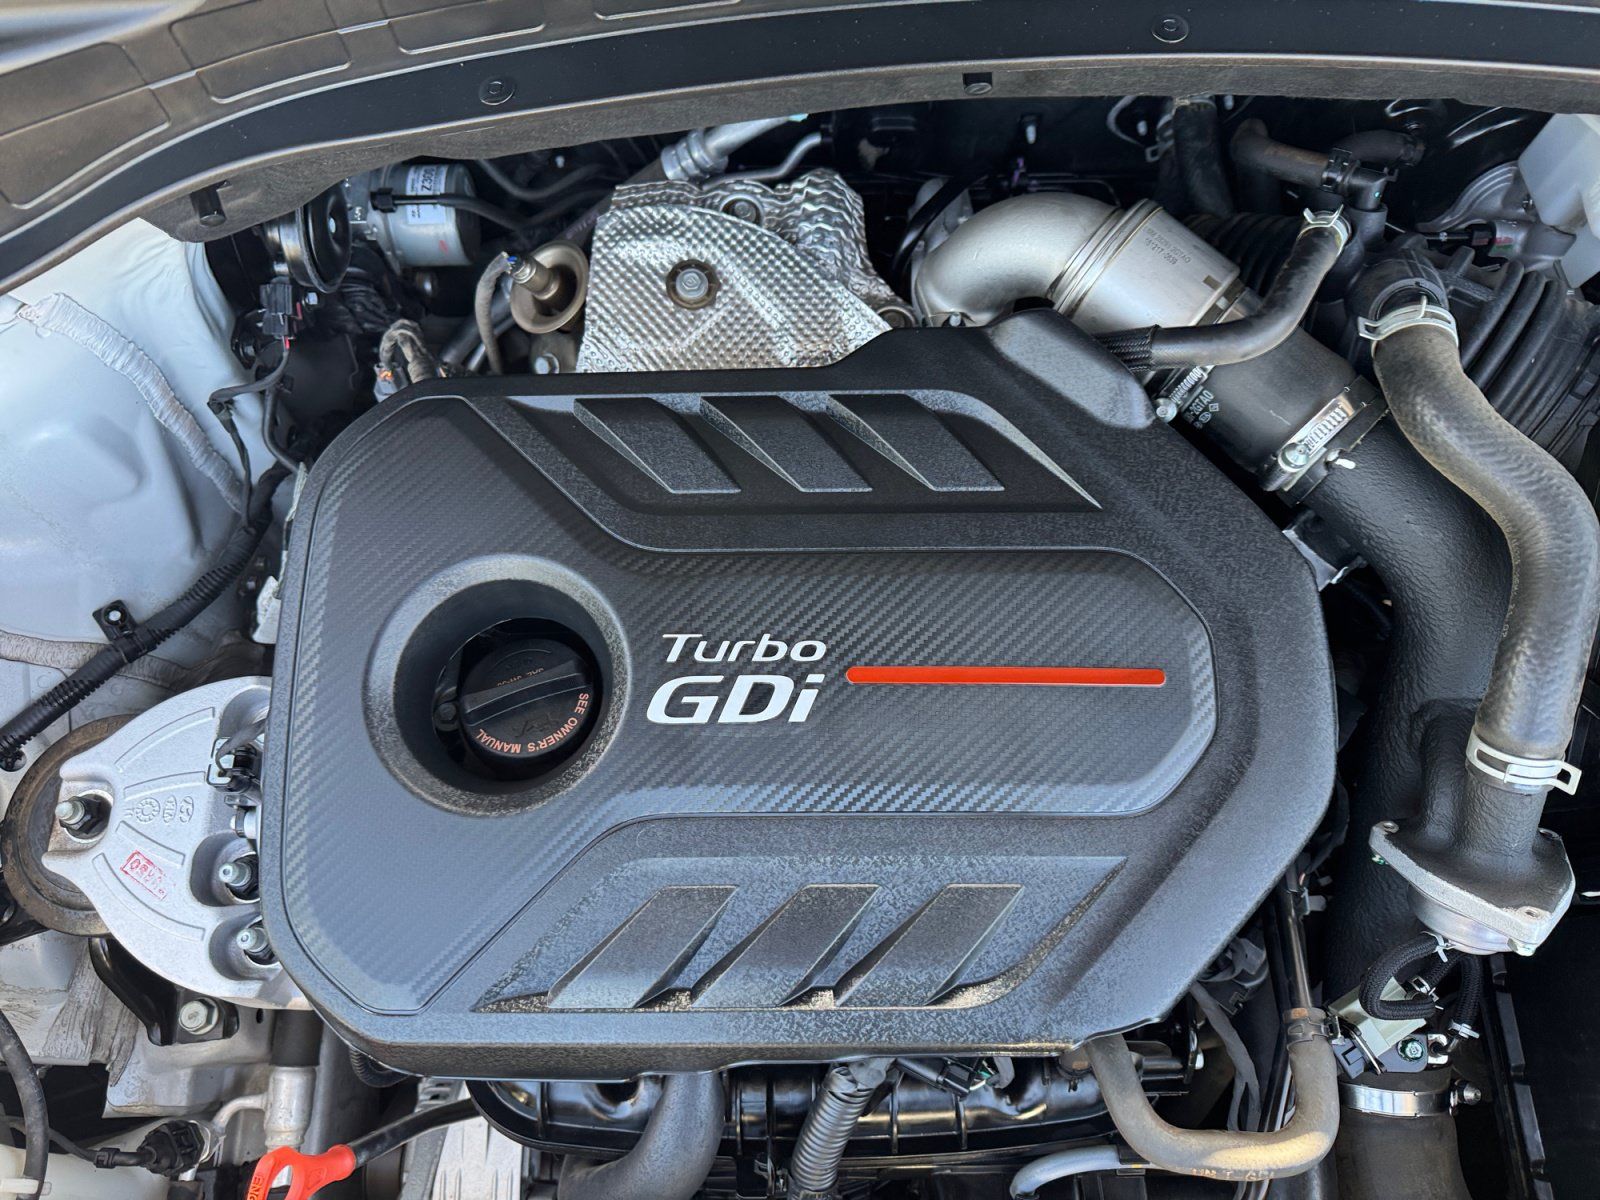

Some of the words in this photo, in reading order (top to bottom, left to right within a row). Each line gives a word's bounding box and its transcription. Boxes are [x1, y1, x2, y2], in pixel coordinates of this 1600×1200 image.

[662, 633, 827, 663] Turbo
[574, 693, 590, 715] SEE
[646, 673, 826, 724] GDi
[476, 728, 521, 753] MANUAL
[527, 717, 578, 752] OWNER'S
